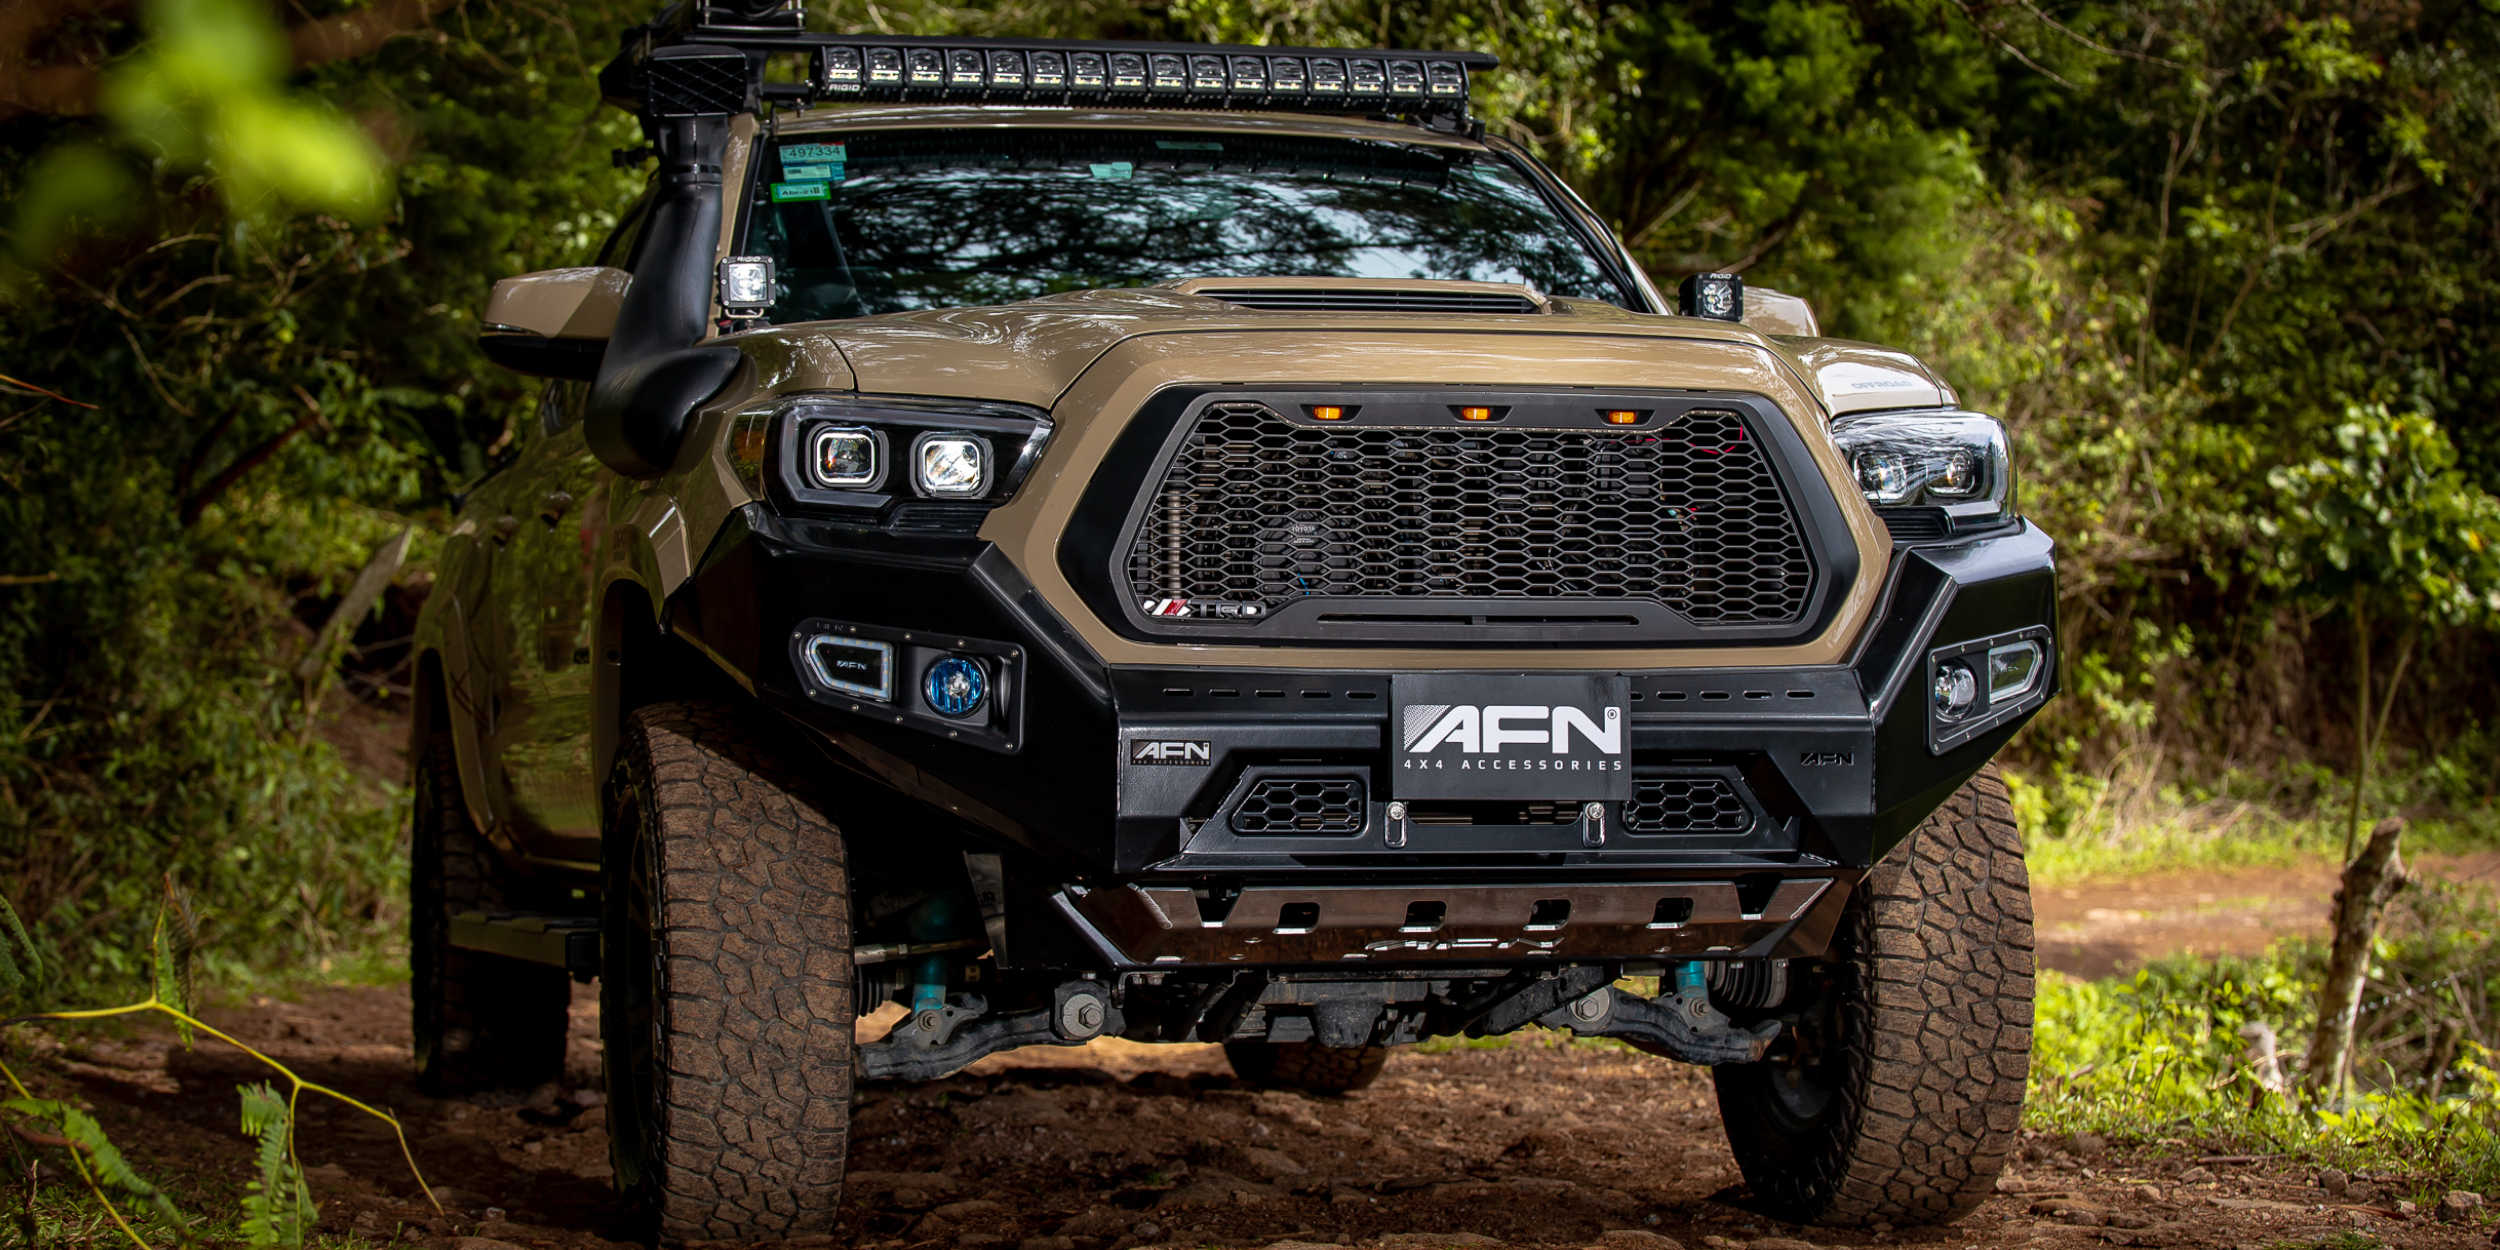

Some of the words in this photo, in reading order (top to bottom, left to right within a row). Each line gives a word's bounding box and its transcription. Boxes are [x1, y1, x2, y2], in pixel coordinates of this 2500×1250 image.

[788, 146, 841, 158] 497334
[1409, 705, 1621, 754] AFN
[1135, 742, 1210, 760] AFN
[1404, 760, 1444, 770] 4X4
[1461, 760, 1622, 771] ACCESSORIES
[1801, 752, 1855, 767] AFN
